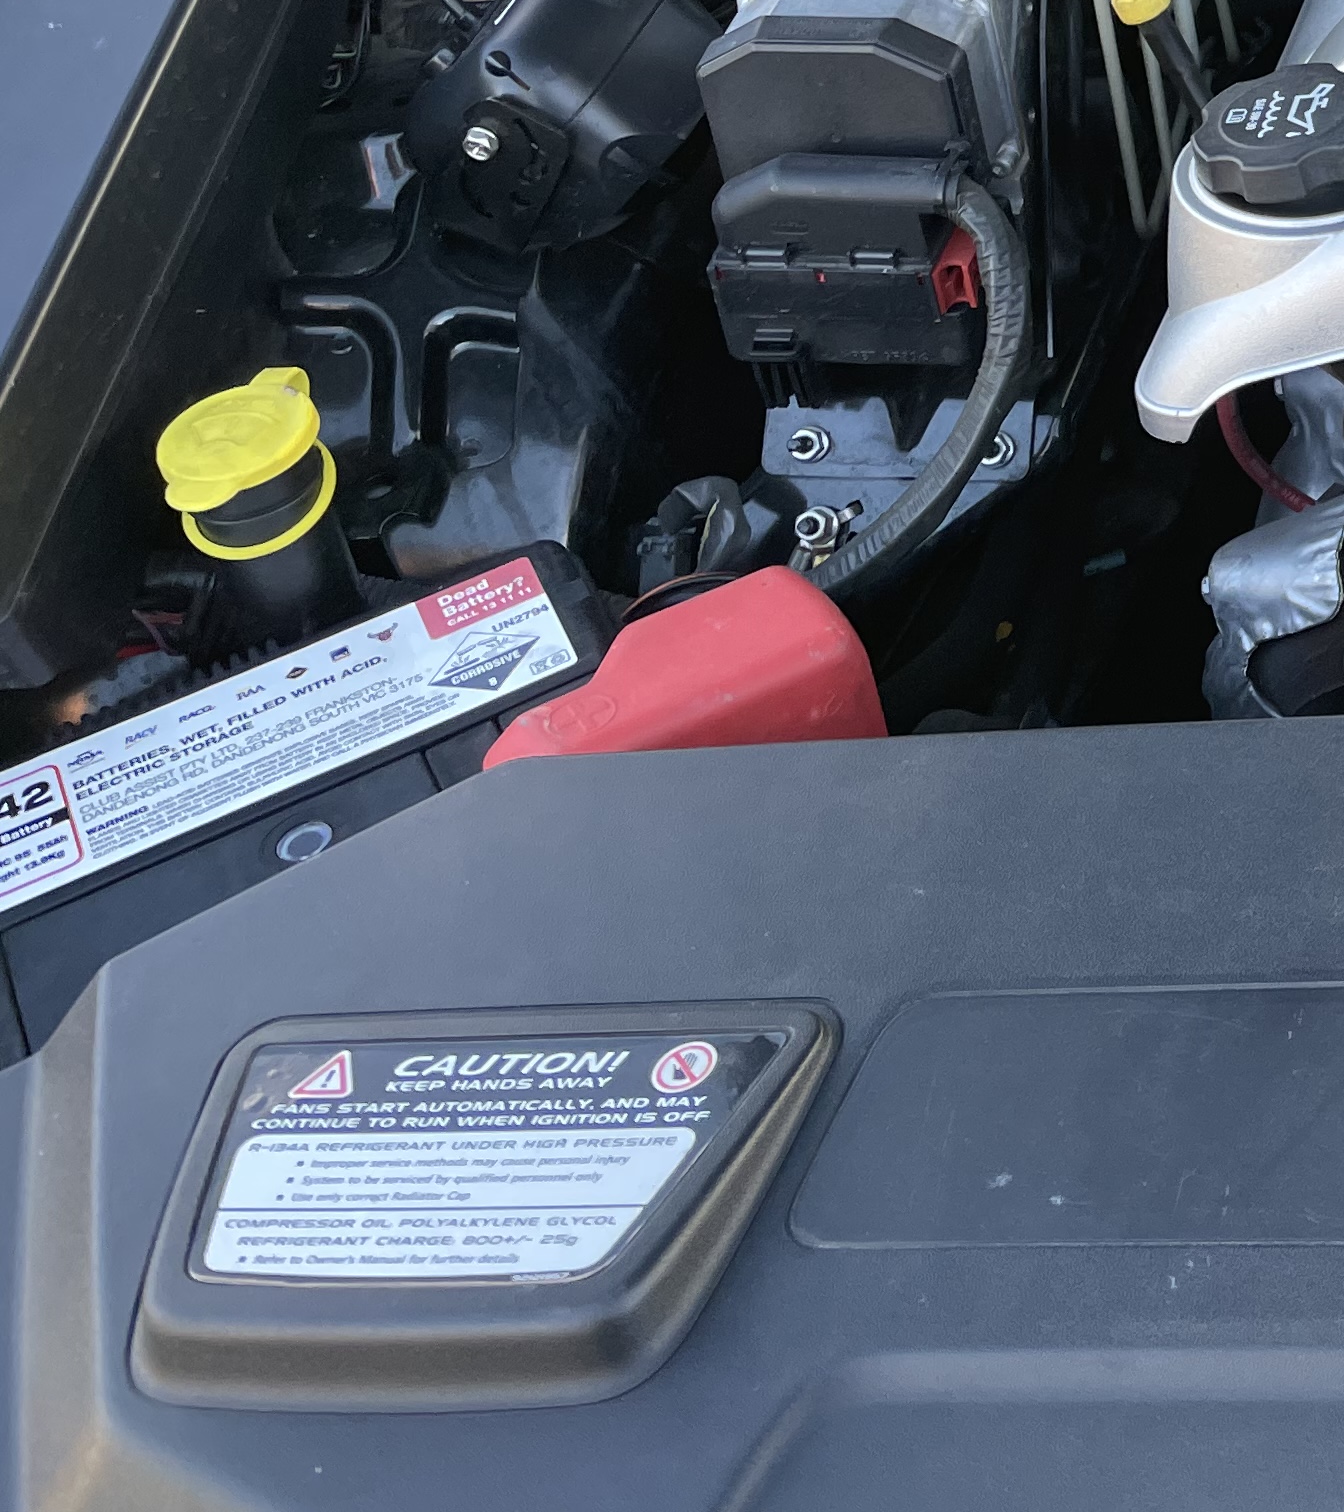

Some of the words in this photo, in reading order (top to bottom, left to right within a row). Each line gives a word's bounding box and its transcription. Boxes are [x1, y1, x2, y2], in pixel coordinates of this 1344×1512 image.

[436, 579, 489, 606] Dead
[441, 576, 526, 617] Battery?
[447, 609, 478, 625] CALL
[482, 601, 496, 610] 13
[501, 594, 513, 603] 11
[519, 587, 531, 595] 11
[492, 604, 549, 632] UN2794
[450, 650, 521, 684] CORROSIVE
[488, 677, 497, 685] 8
[71, 742, 175, 790] BATTERIES,
[179, 722, 223, 746] WET,
[226, 695, 287, 725] FILLED
[291, 675, 336, 698] WITH
[75, 757, 166, 800] ELECTRIC
[168, 721, 254, 761] STORAGE
[81, 777, 178, 822] DANDENONG
[210, 723, 306, 768] DANDENONG
[308, 700, 360, 726] SOUTH
[362, 689, 386, 704] VIC
[78, 791, 120, 814] CLUB
[122, 768, 176, 795] ASSIST
[178, 755, 208, 773] PTY
[1, 816, 54, 845] Battery
[86, 805, 148, 834] WARNING
[393, 1050, 631, 1077] CAUTION!
[385, 1080, 446, 1093] KEEP
[450, 1078, 534, 1092] HANDS
[538, 1076, 613, 1090] AWAY
[270, 1102, 331, 1115] FANS
[336, 1101, 410, 1114] START
[600, 1097, 650, 1109] AND
[656, 1096, 708, 1108] MAY
[250, 1116, 361, 1130] CONTINUE
[368, 1117, 397, 1129] TO
[402, 1116, 451, 1128] RUN
[456, 1115, 525, 1127] WHEN
[530, 1113, 628, 1126] IGNITION
[634, 1111, 658, 1124] IS
[662, 1110, 712, 1123] OFF
[248, 1142, 310, 1153] R-134A
[315, 1140, 446, 1152] REFRIGERANT
[451, 1140, 516, 1150] UNDER
[523, 1139, 568, 1150] HIGH
[573, 1136, 679, 1148] PRESSURE
[471, 1159, 498, 1168] may
[537, 1155, 594, 1168] personal
[595, 1155, 631, 1166] injury
[574, 1171, 604, 1184] only
[224, 1218, 357, 1229] COMPRESSOR
[397, 1217, 541, 1228] POLYALKYLENE
[546, 1216, 618, 1227] GLYCOL
[236, 1236, 372, 1247] REFRIGERANT
[540, 1233, 579, 1247] 25g
